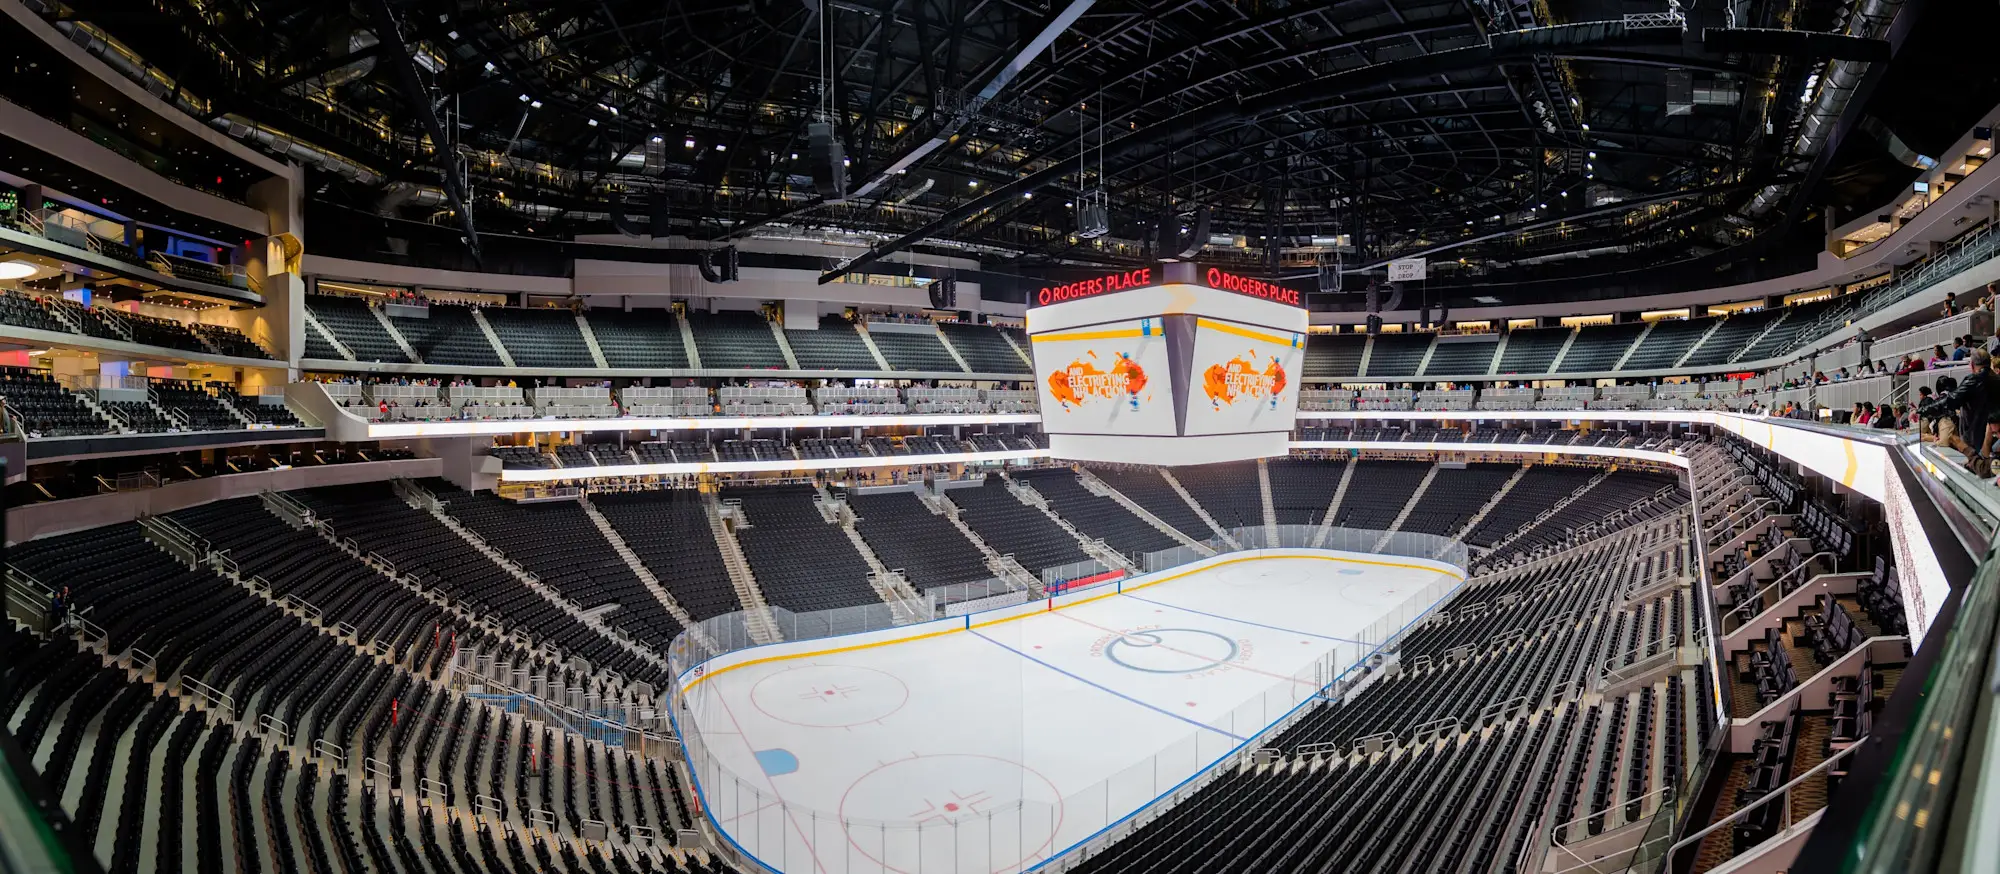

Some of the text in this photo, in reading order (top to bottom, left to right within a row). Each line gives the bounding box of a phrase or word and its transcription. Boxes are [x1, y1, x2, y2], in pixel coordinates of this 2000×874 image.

[1053, 268, 1150, 302] ROGERS PLACE
[1223, 272, 1299, 305] ROGERS PLACE
[1068, 366, 1083, 376] AND
[1229, 363, 1241, 373] AND
[1068, 373, 1129, 387] ELECTRIFYING
[1225, 374, 1275, 386] ELECTRIFYING
